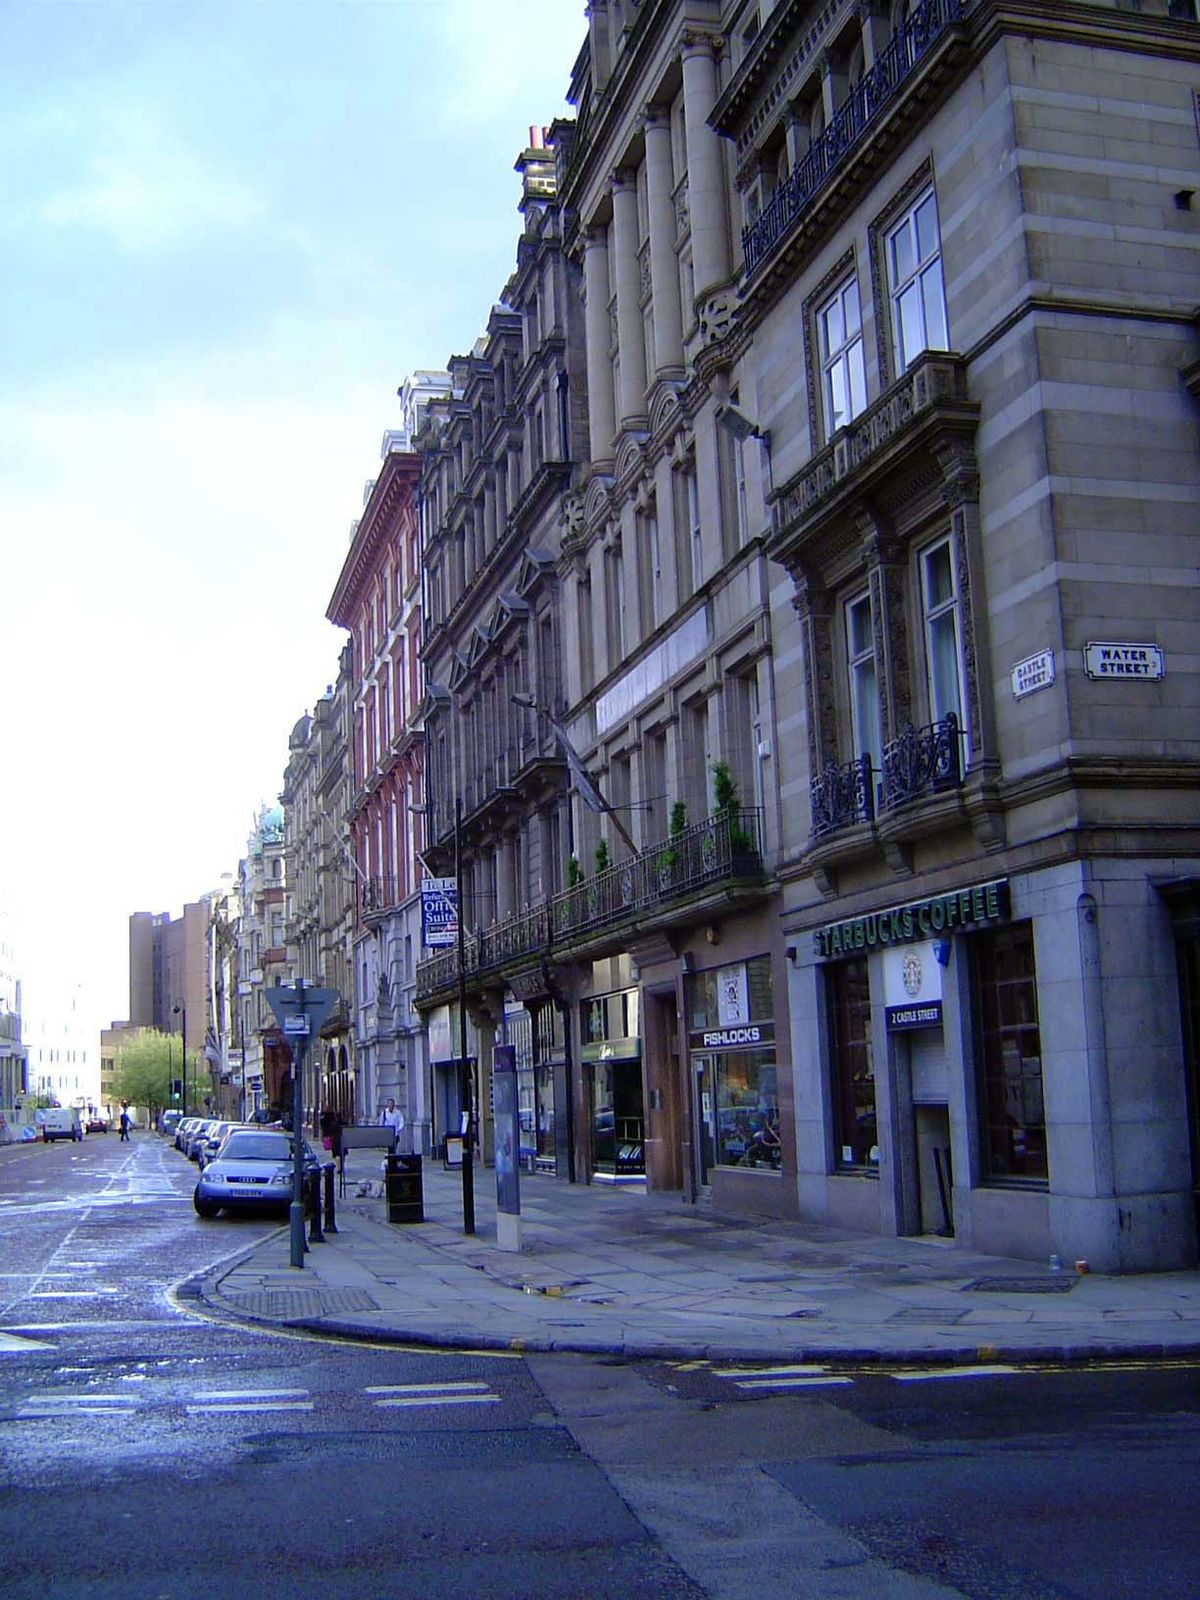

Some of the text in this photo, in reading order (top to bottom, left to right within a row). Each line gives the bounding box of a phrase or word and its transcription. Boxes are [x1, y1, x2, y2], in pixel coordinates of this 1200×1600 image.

[1101, 649, 1147, 661] WATER
[1017, 657, 1046, 678] CASTLE
[1100, 662, 1149, 674] STREET
[1018, 671, 1046, 690] STREET
[424, 900, 459, 912] Offi
[813, 882, 1000, 956] STARBUCKS COFFEE
[892, 1008, 938, 1023] 2 CASTLE STREET
[703, 1027, 760, 1047] FISHLOCKS
